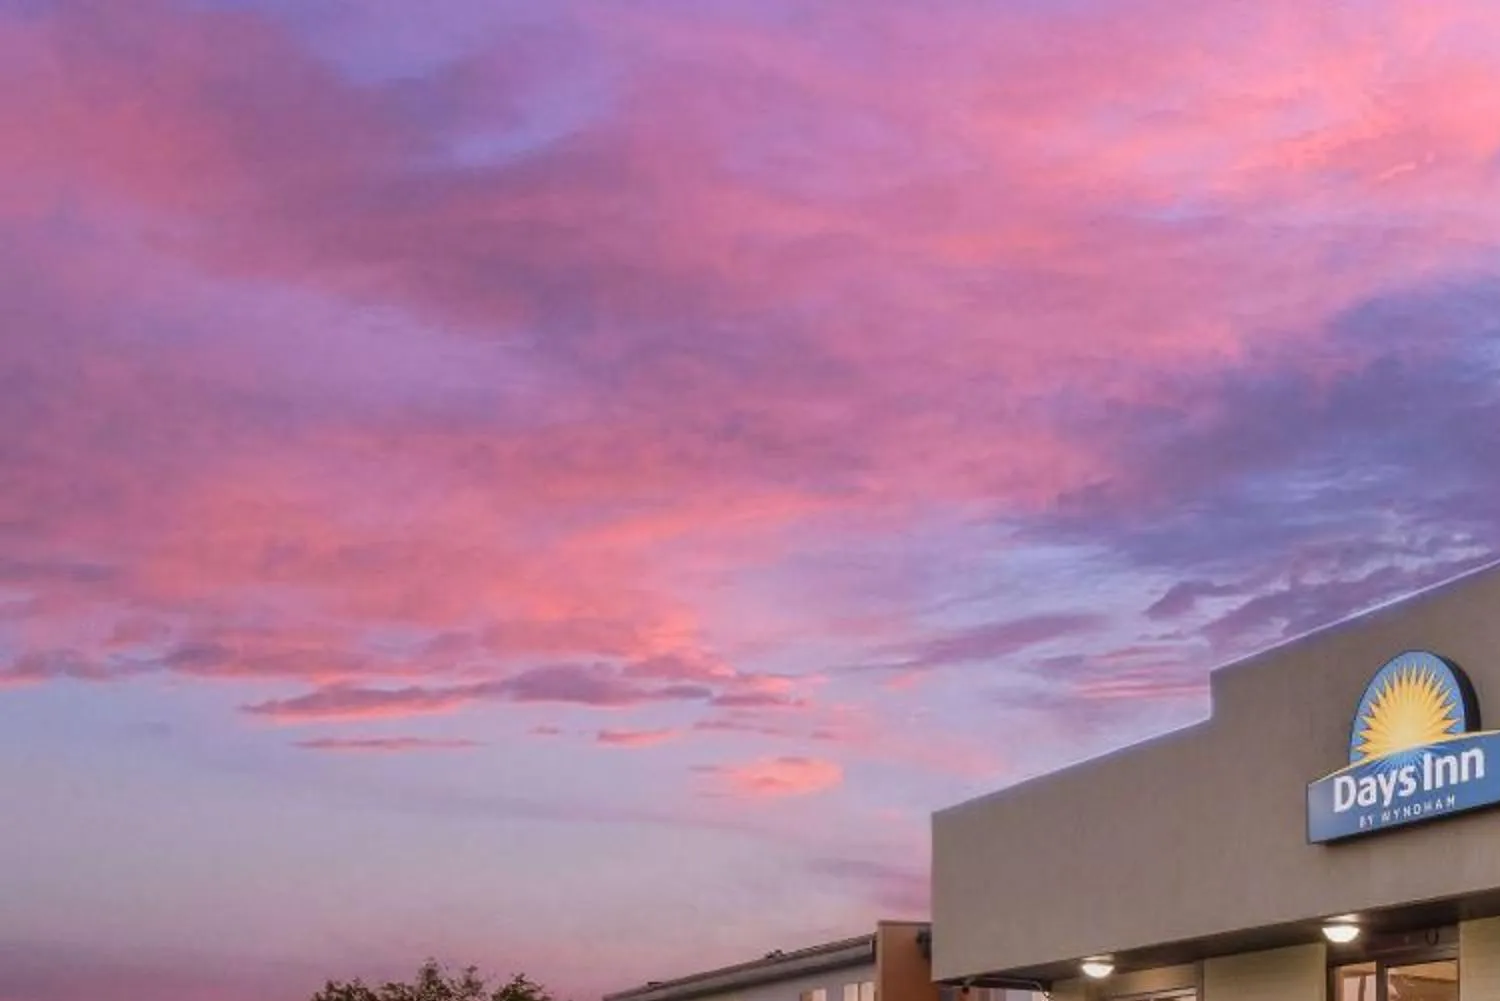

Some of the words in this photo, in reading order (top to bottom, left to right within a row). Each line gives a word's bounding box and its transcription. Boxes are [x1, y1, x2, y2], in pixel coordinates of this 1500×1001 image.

[1333, 764, 1417, 813] Days
[1423, 747, 1485, 791] Inn
[1359, 815, 1373, 829] BY
[1381, 794, 1456, 822] WYNDHAM
